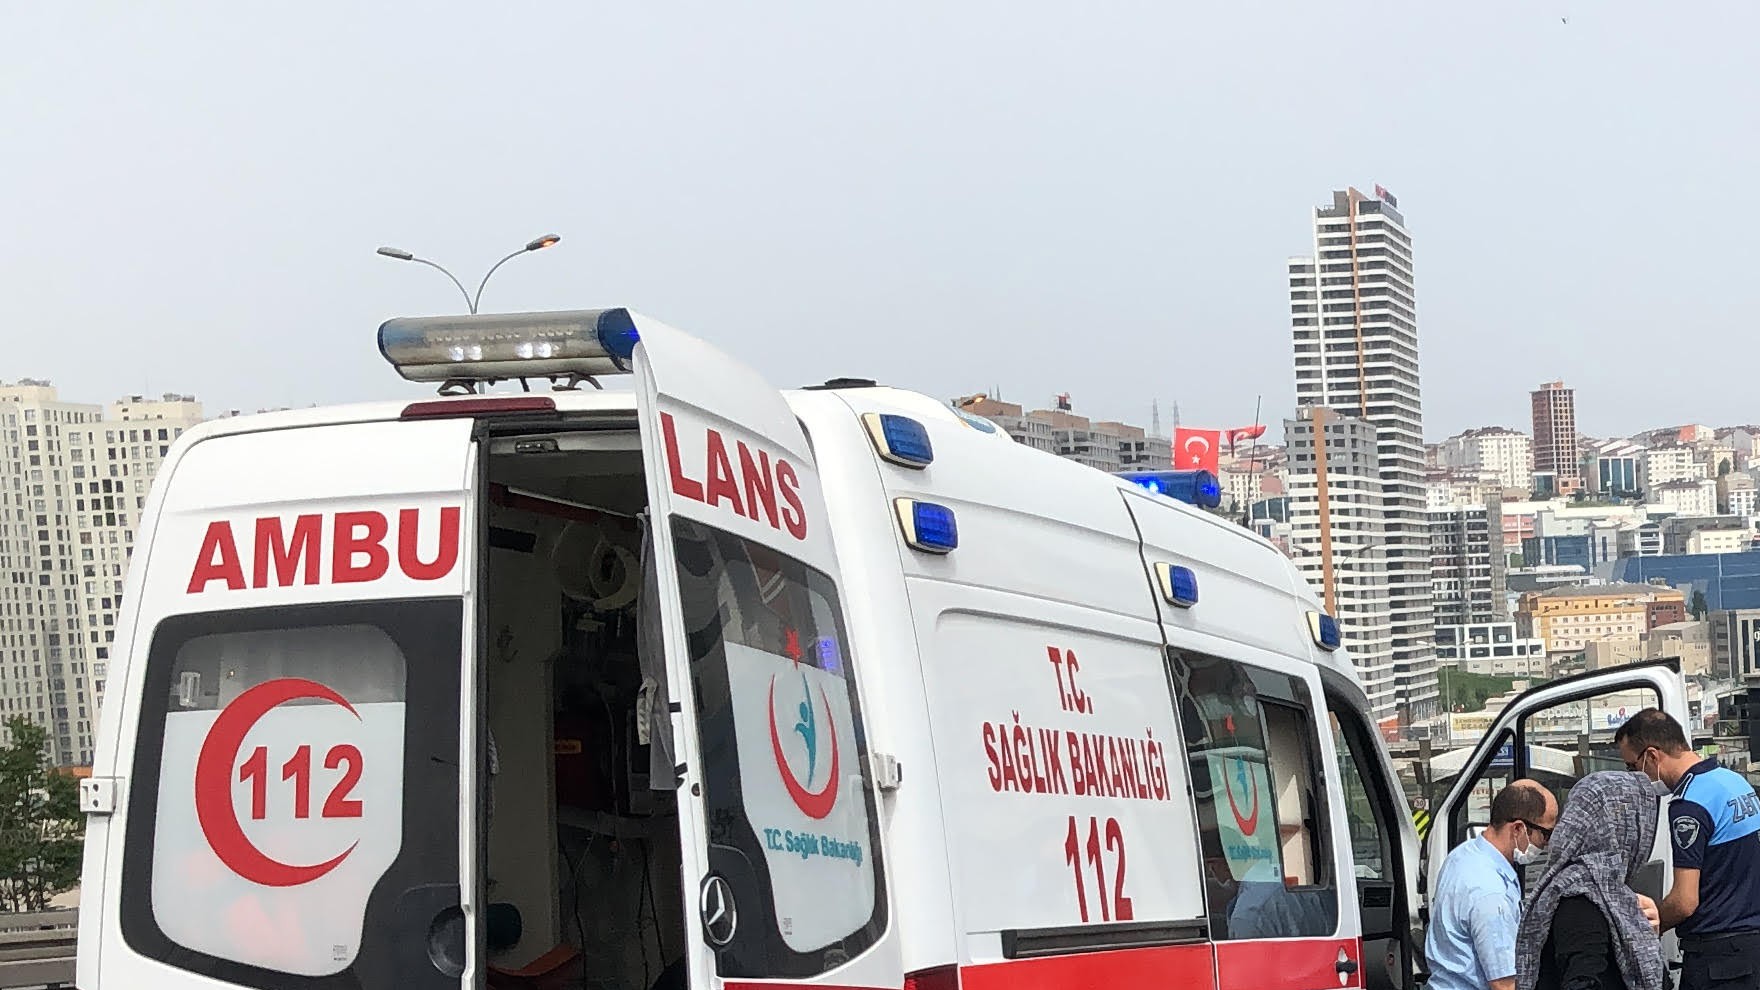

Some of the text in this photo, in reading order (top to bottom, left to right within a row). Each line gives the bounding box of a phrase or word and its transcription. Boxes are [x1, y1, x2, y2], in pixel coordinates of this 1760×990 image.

[660, 411, 807, 541] LANS
[186, 506, 461, 594] AMBU
[1047, 646, 1093, 714] T.C.
[240, 744, 363, 819] 112
[982, 710, 1171, 800] SAĞLIK BAKANLIĞI
[784, 830, 819, 859] Sağlık
[821, 836, 862, 867] Bakanlığı
[1064, 815, 1134, 923] 112
